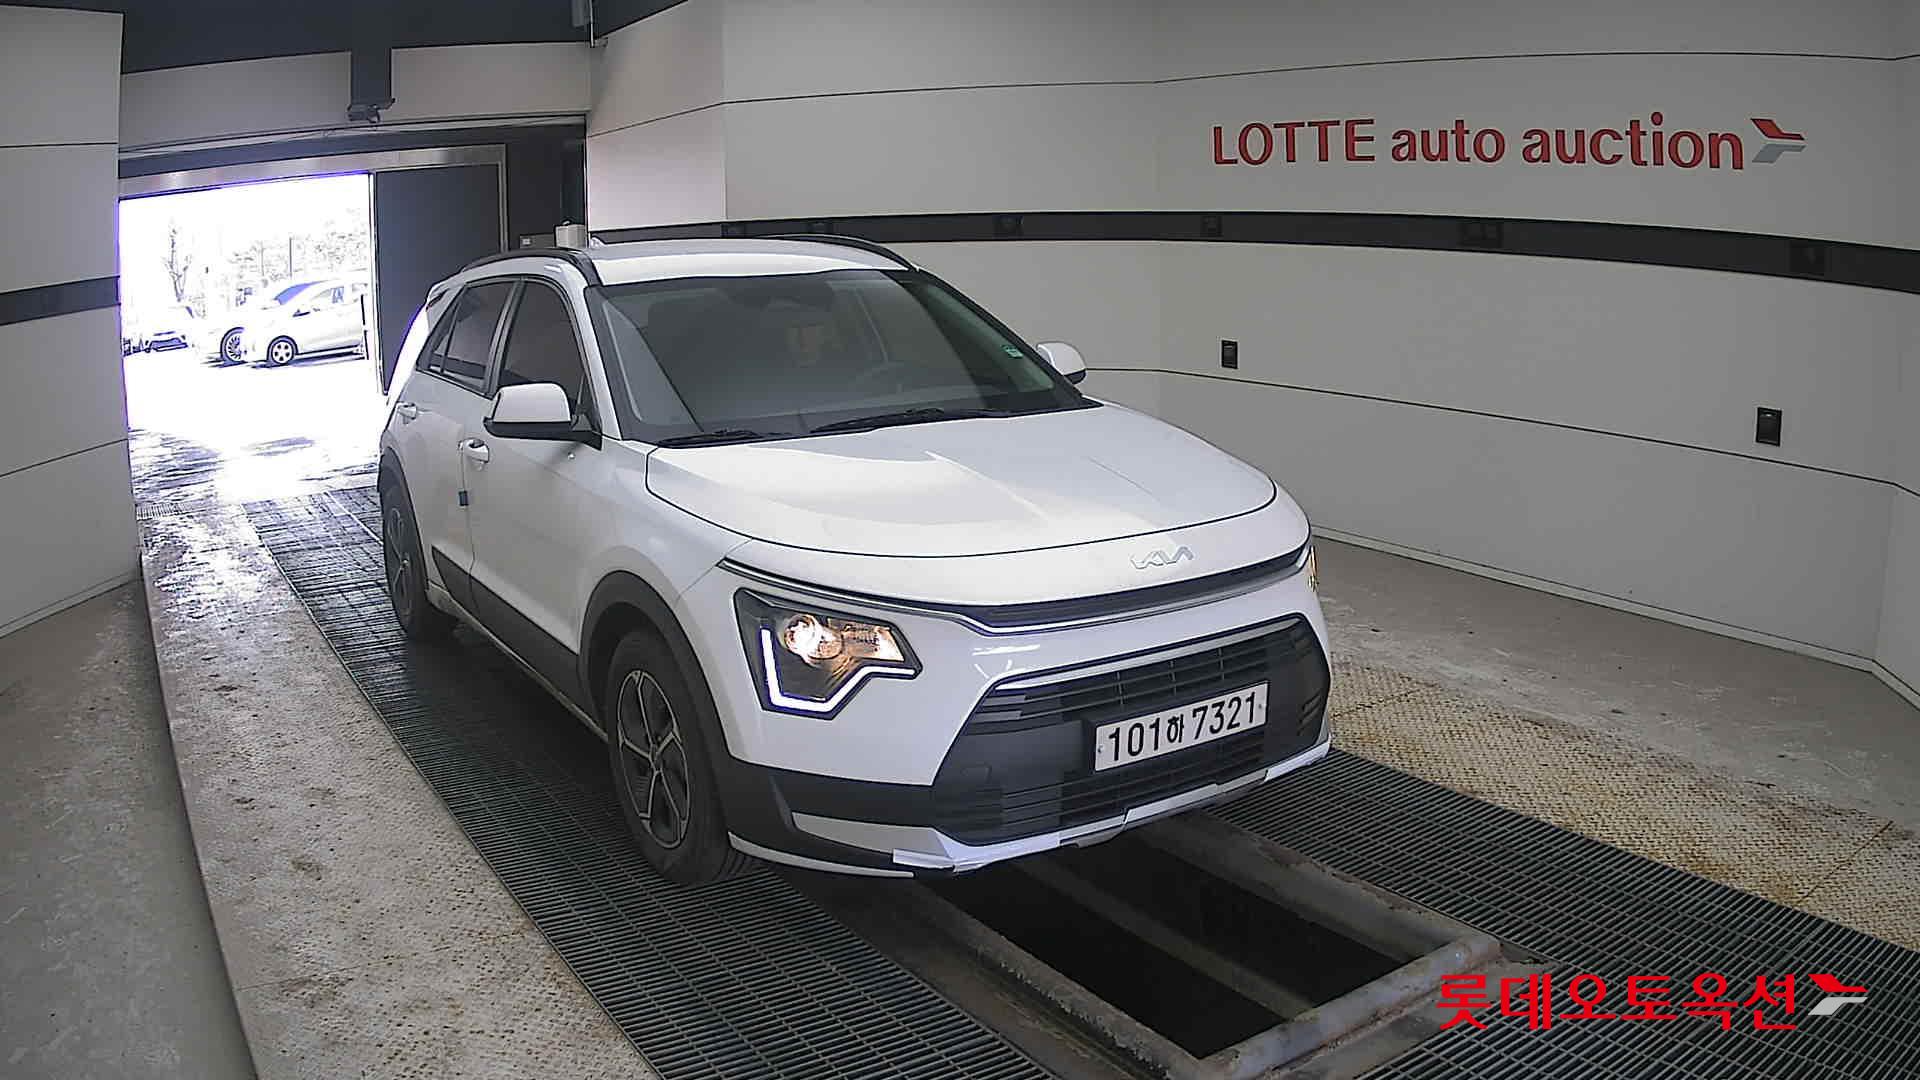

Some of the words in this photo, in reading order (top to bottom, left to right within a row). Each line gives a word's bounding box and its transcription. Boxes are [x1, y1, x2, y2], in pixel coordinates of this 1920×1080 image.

[1213, 119, 1376, 165] LOTTE
[1391, 119, 1505, 163] auto
[1522, 112, 1744, 170] auction
[1108, 713, 1185, 762] 101하
[1192, 691, 1256, 740] 7321
